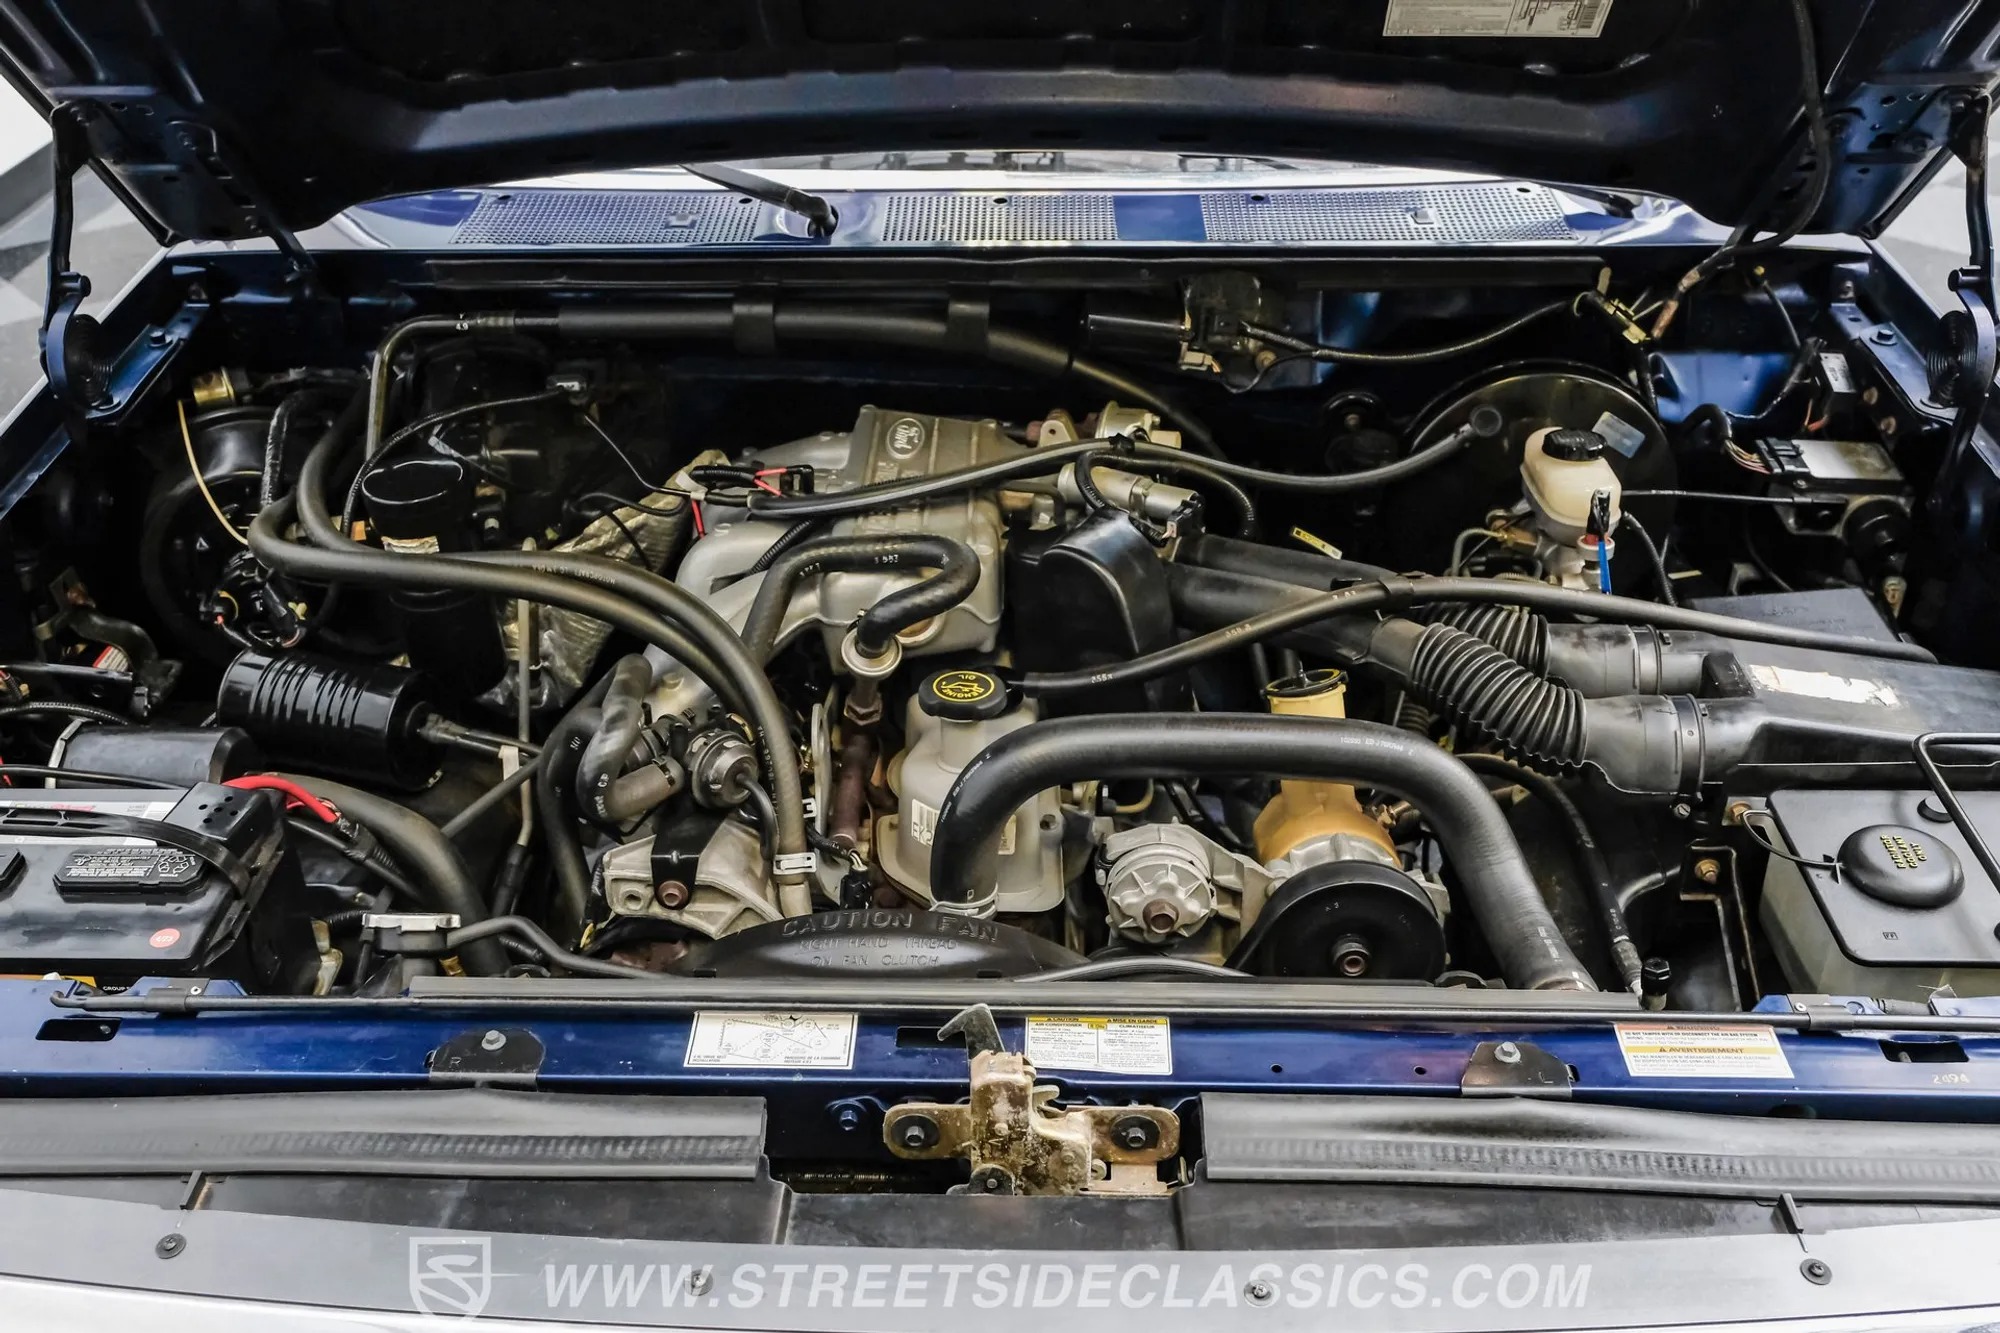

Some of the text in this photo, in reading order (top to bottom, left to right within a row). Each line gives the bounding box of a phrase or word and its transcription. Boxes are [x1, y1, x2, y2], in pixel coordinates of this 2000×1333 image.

[893, 424, 919, 449] Ford
[941, 688, 980, 698] ENGINE
[1880, 834, 1907, 869] RADIATOR
[1892, 835, 1918, 869] COOLANT
[1909, 842, 1927, 862] ONLY
[782, 911, 999, 943] CAUTION FAN
[847, 938, 889, 949] HAND
[905, 938, 958, 951] THREAD
[811, 954, 939, 967] ON FAN CLUTCH
[1668, 1046, 1745, 1054] AVERTISSEMENT
